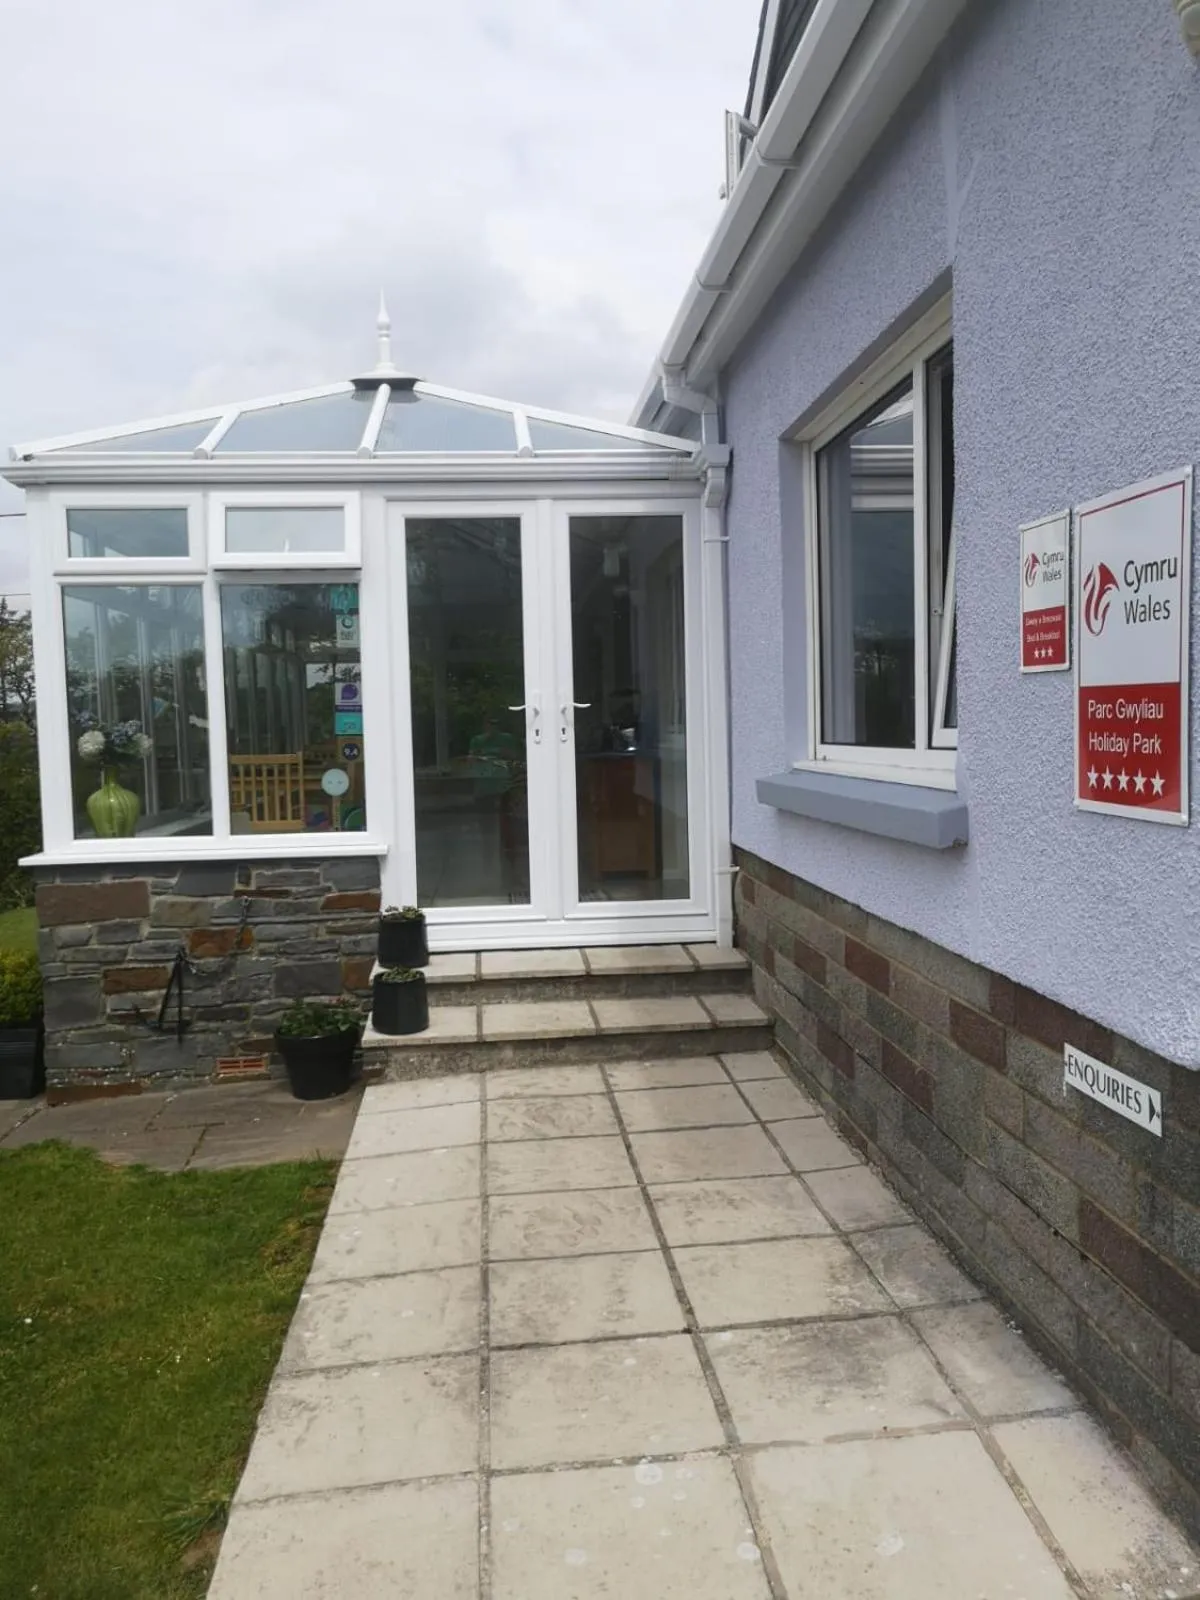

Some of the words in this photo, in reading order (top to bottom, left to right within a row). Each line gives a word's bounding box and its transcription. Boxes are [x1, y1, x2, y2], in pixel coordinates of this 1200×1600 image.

[1042, 552, 1064, 568] Cymru
[1042, 569, 1062, 583] Wales
[1123, 557, 1178, 594] Cymru
[1124, 594, 1171, 625] Wales
[1088, 699, 1113, 719] Parc
[1115, 698, 1164, 724] Gwyliau
[1088, 731, 1130, 758] Holiday
[1133, 732, 1162, 755] Park
[1068, 1054, 1142, 1114] ENQUIRIES
